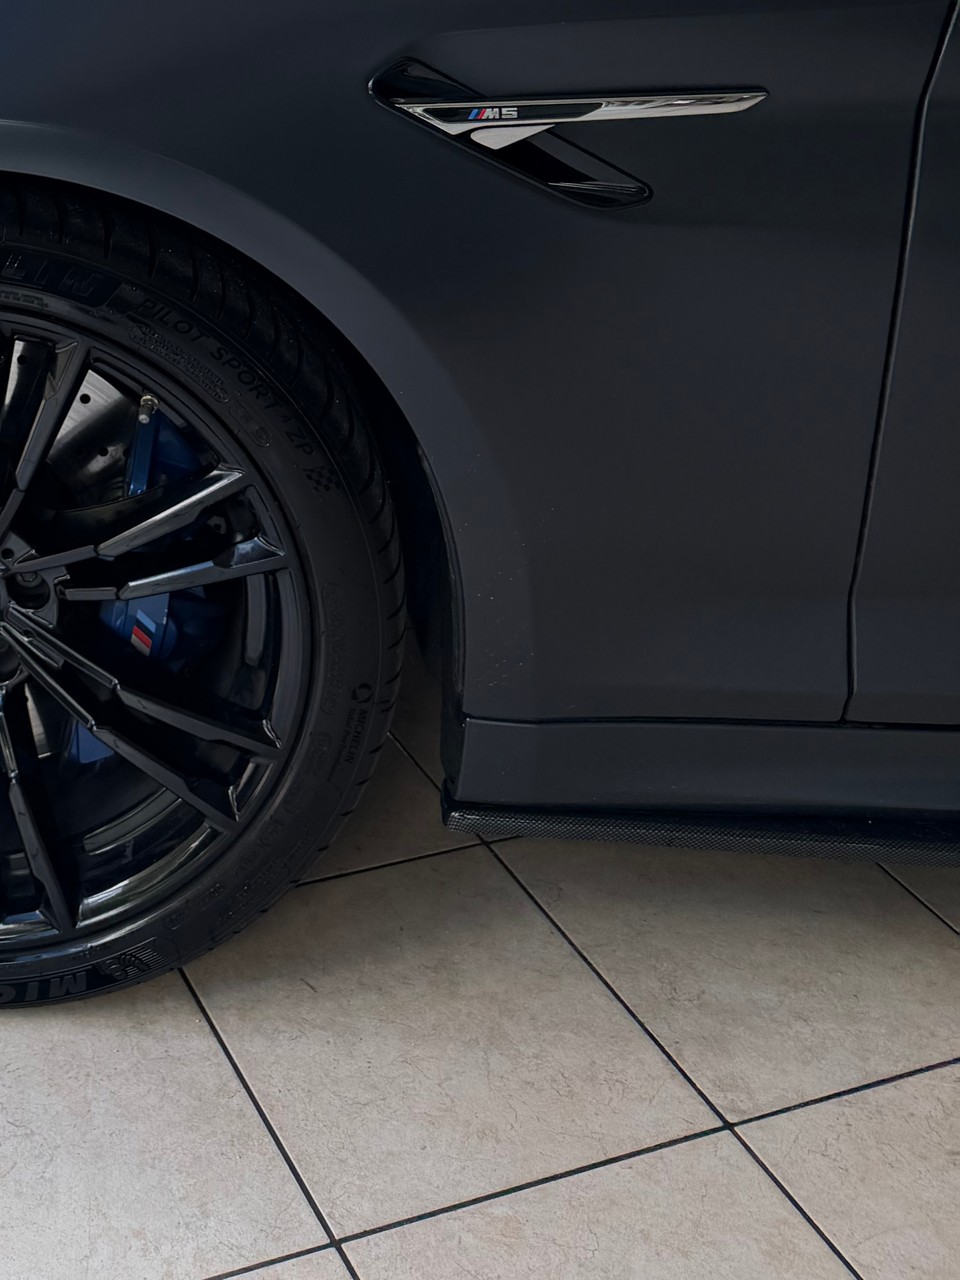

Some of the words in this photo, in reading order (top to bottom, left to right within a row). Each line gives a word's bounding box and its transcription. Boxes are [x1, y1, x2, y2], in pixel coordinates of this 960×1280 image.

[481, 107, 518, 119] M5
[140, 299, 208, 342] PILOT
[209, 346, 284, 411] SPORT
[286, 427, 315, 457] ZP
[343, 707, 369, 764] MICHELIN
